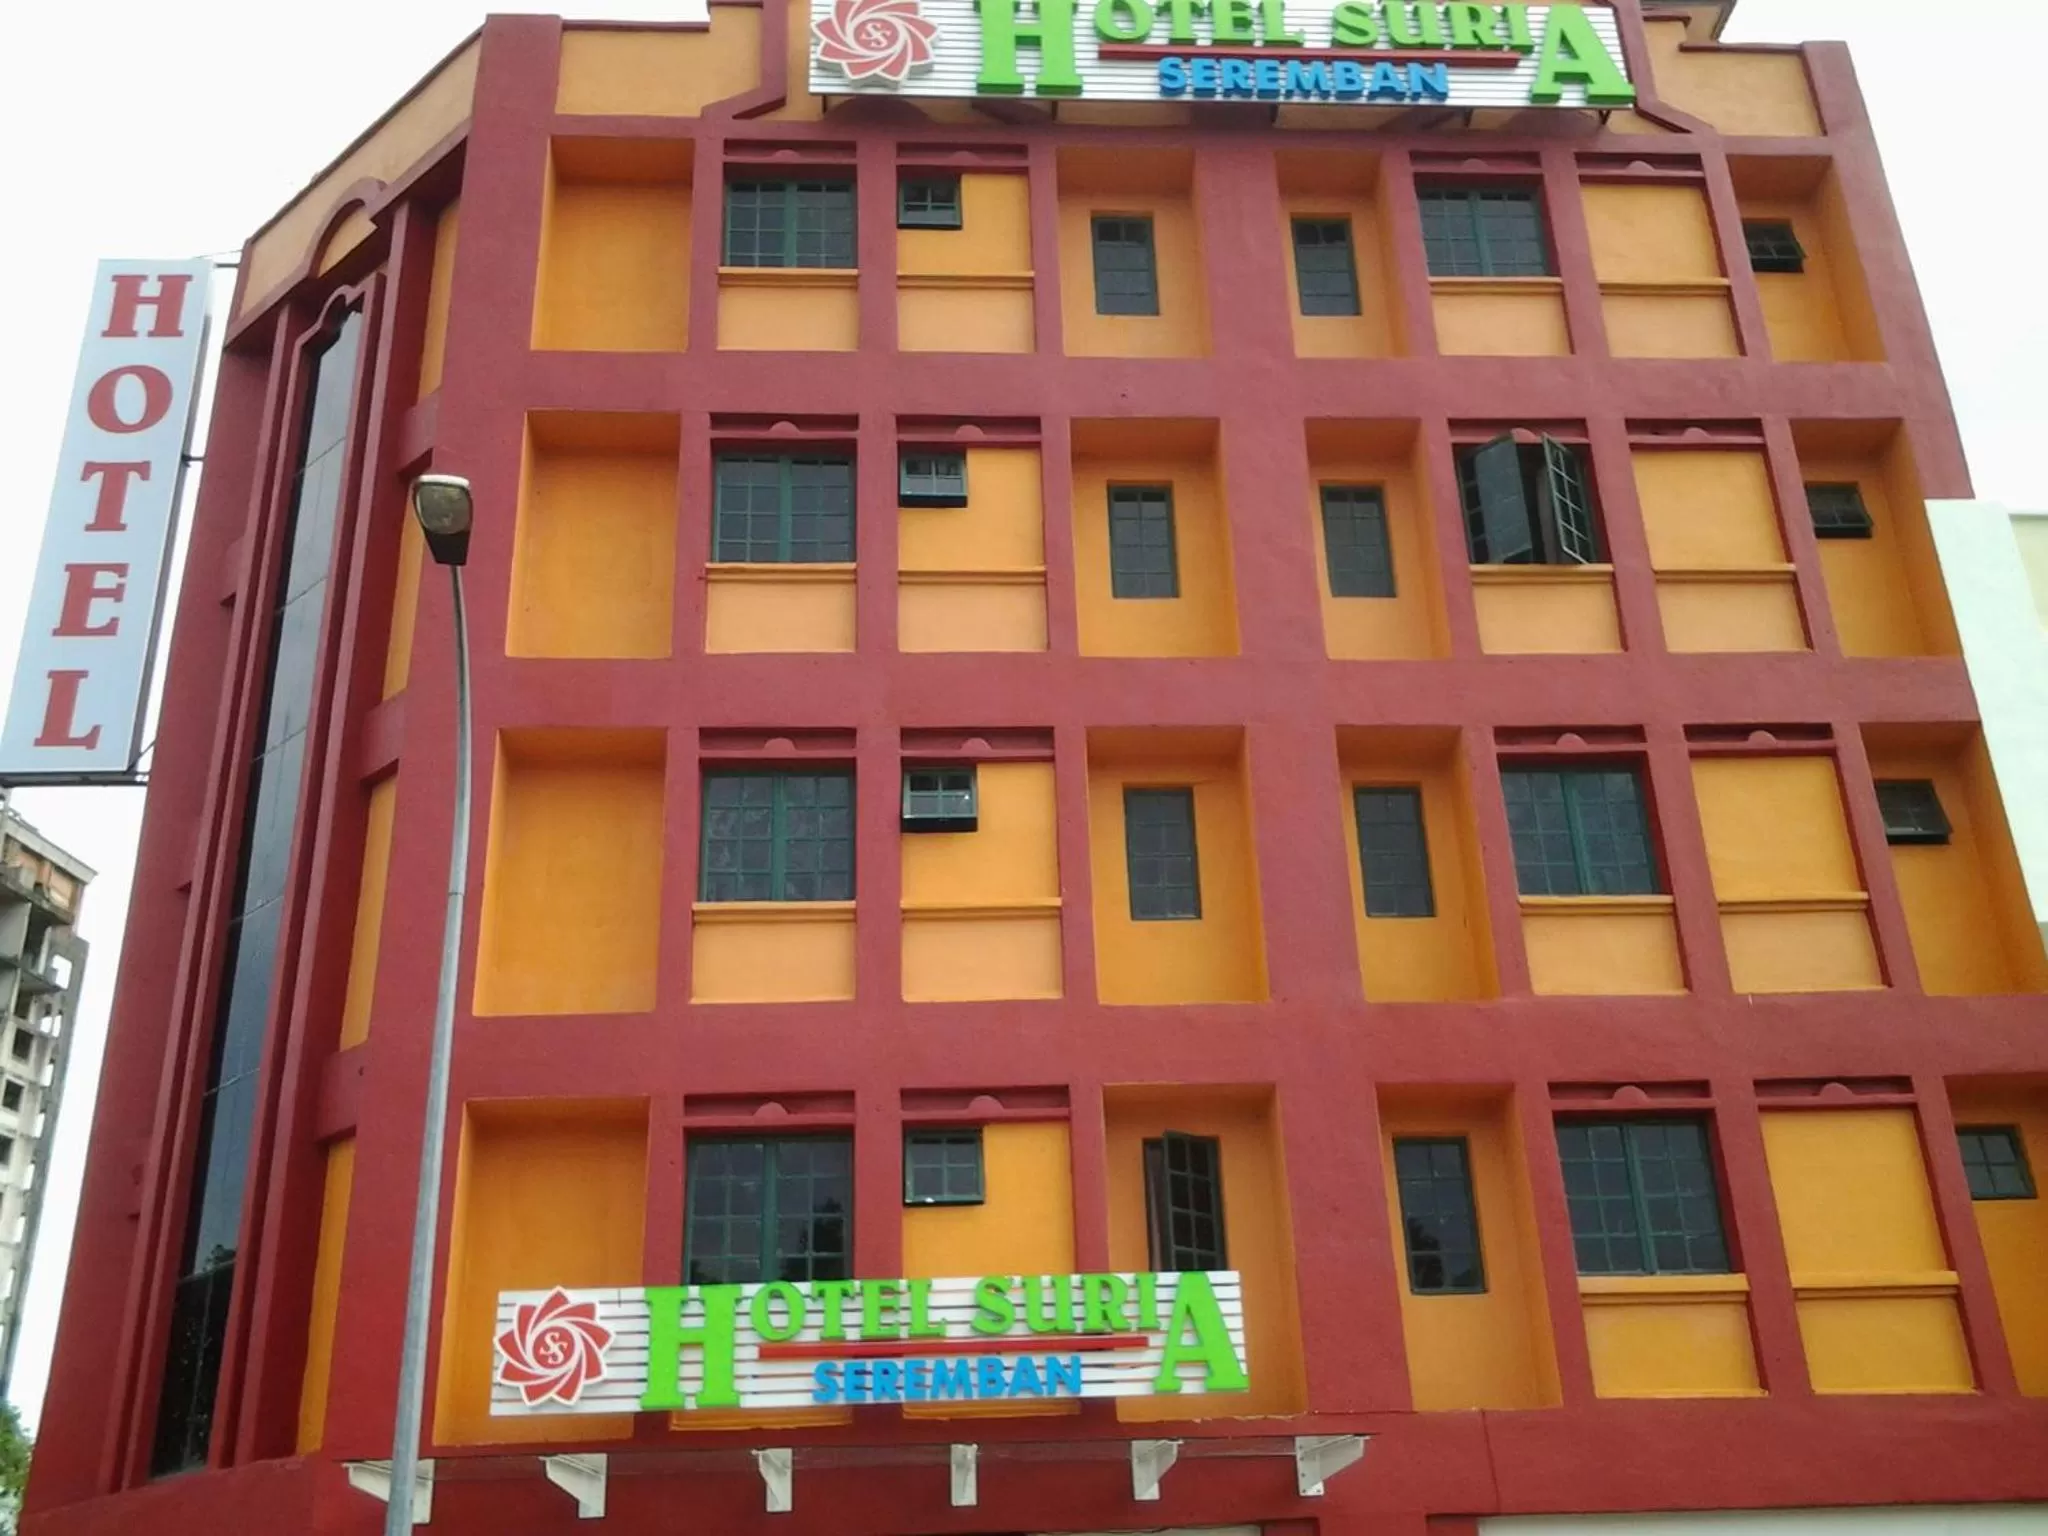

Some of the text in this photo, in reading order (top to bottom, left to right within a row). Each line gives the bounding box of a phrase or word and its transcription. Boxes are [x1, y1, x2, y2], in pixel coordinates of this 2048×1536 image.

[974, 0, 1636, 104] HOTEL SURIA
[1158, 57, 1449, 102] SEREMBAN
[34, 274, 193, 751] HOTEL
[640, 1271, 1250, 1410] HOTEL SURIA
[812, 1355, 1082, 1403] SEREMBAN
